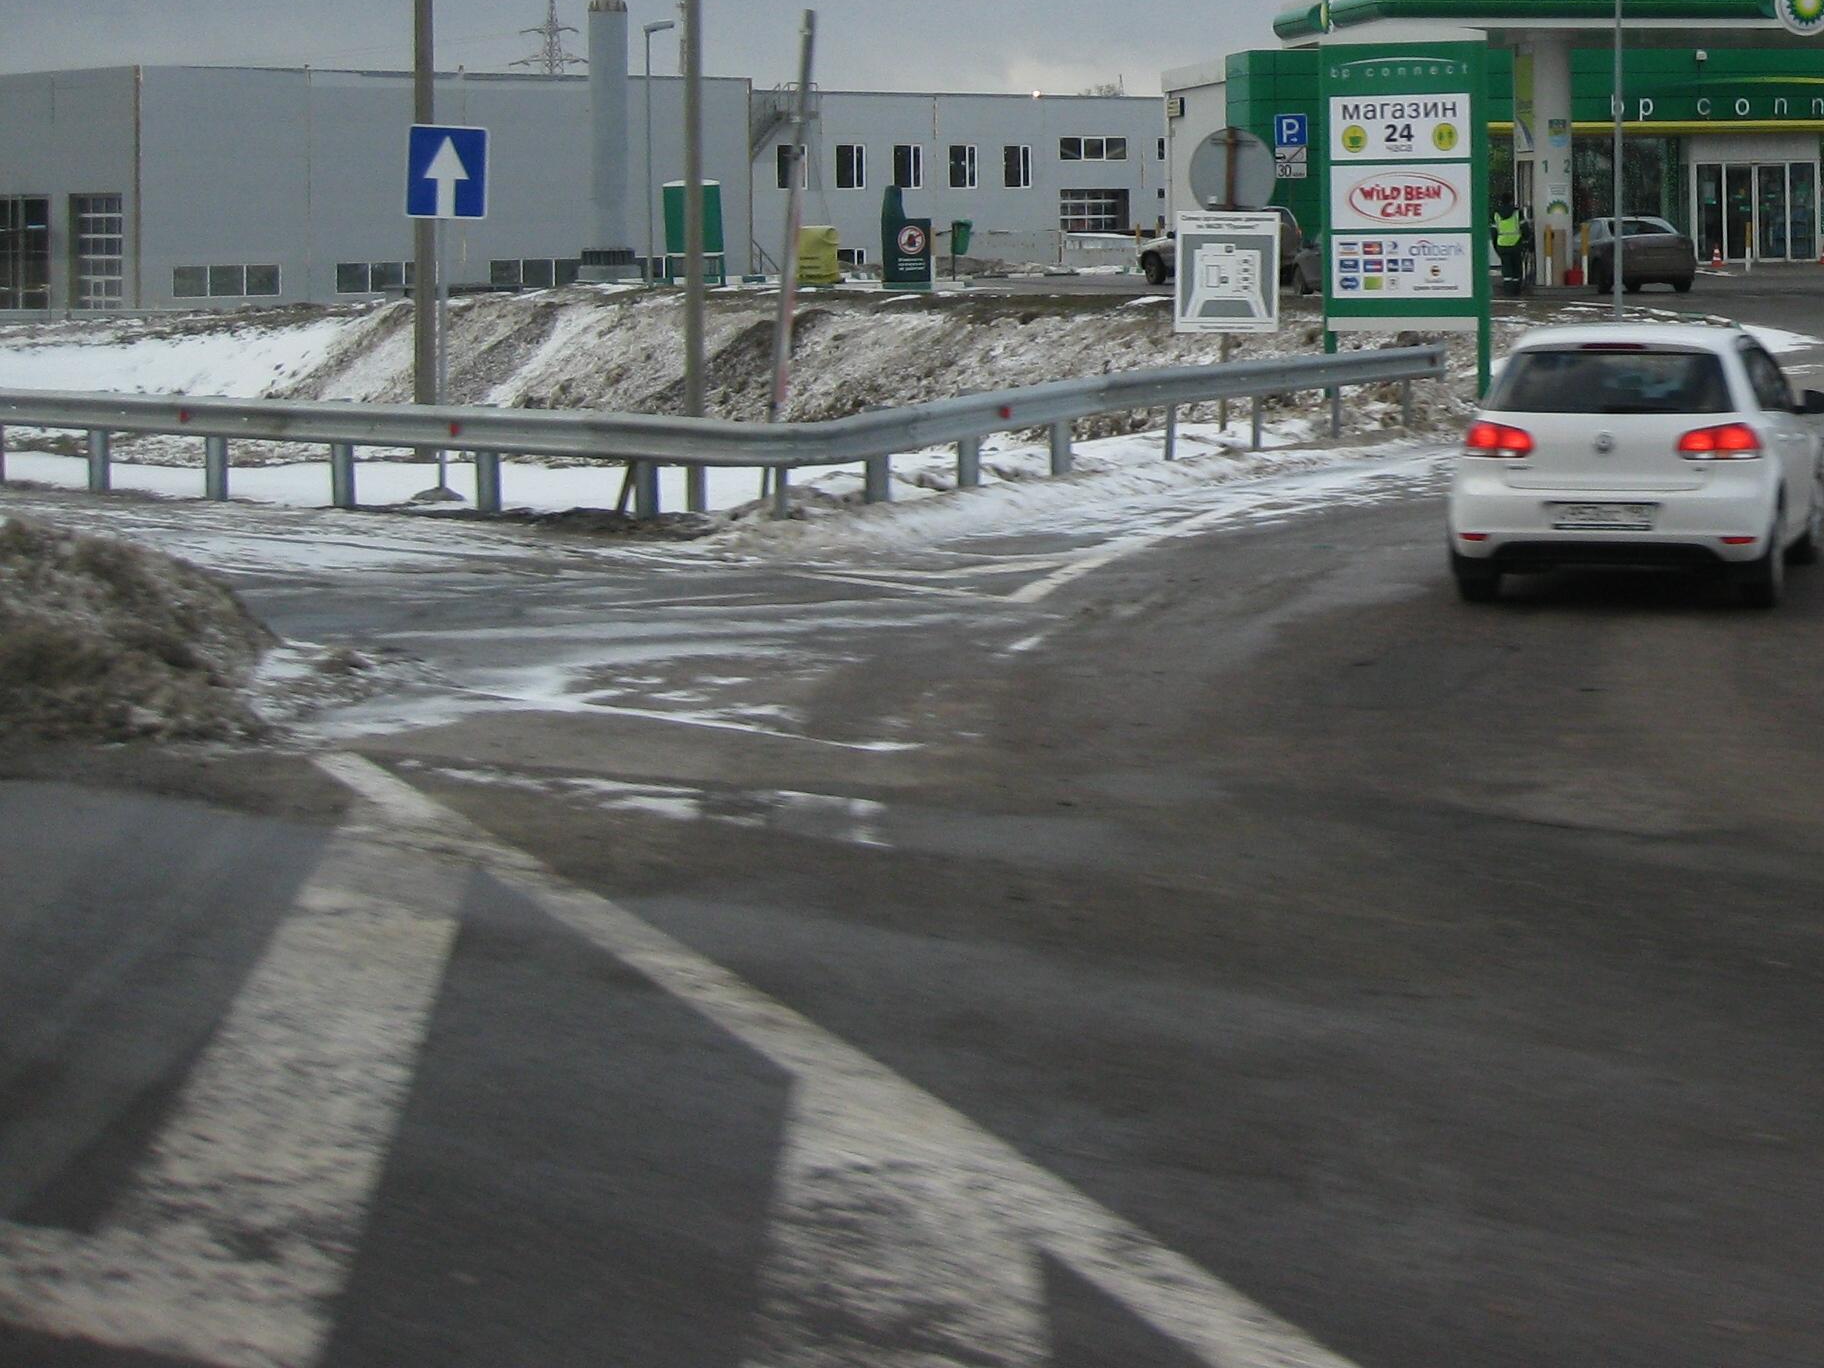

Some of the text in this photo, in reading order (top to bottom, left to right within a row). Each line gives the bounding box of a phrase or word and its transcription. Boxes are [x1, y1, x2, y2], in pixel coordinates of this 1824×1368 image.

[1365, 63, 1468, 78] connect
[1342, 101, 1457, 120] магазин
[1384, 123, 1414, 142] 24
[1278, 165, 1291, 177] 30
[1542, 160, 1548, 173] 1
[1564, 159, 1570, 173] 2
[1404, 185, 1441, 201] BEAN
[1381, 203, 1422, 217] CAFE
